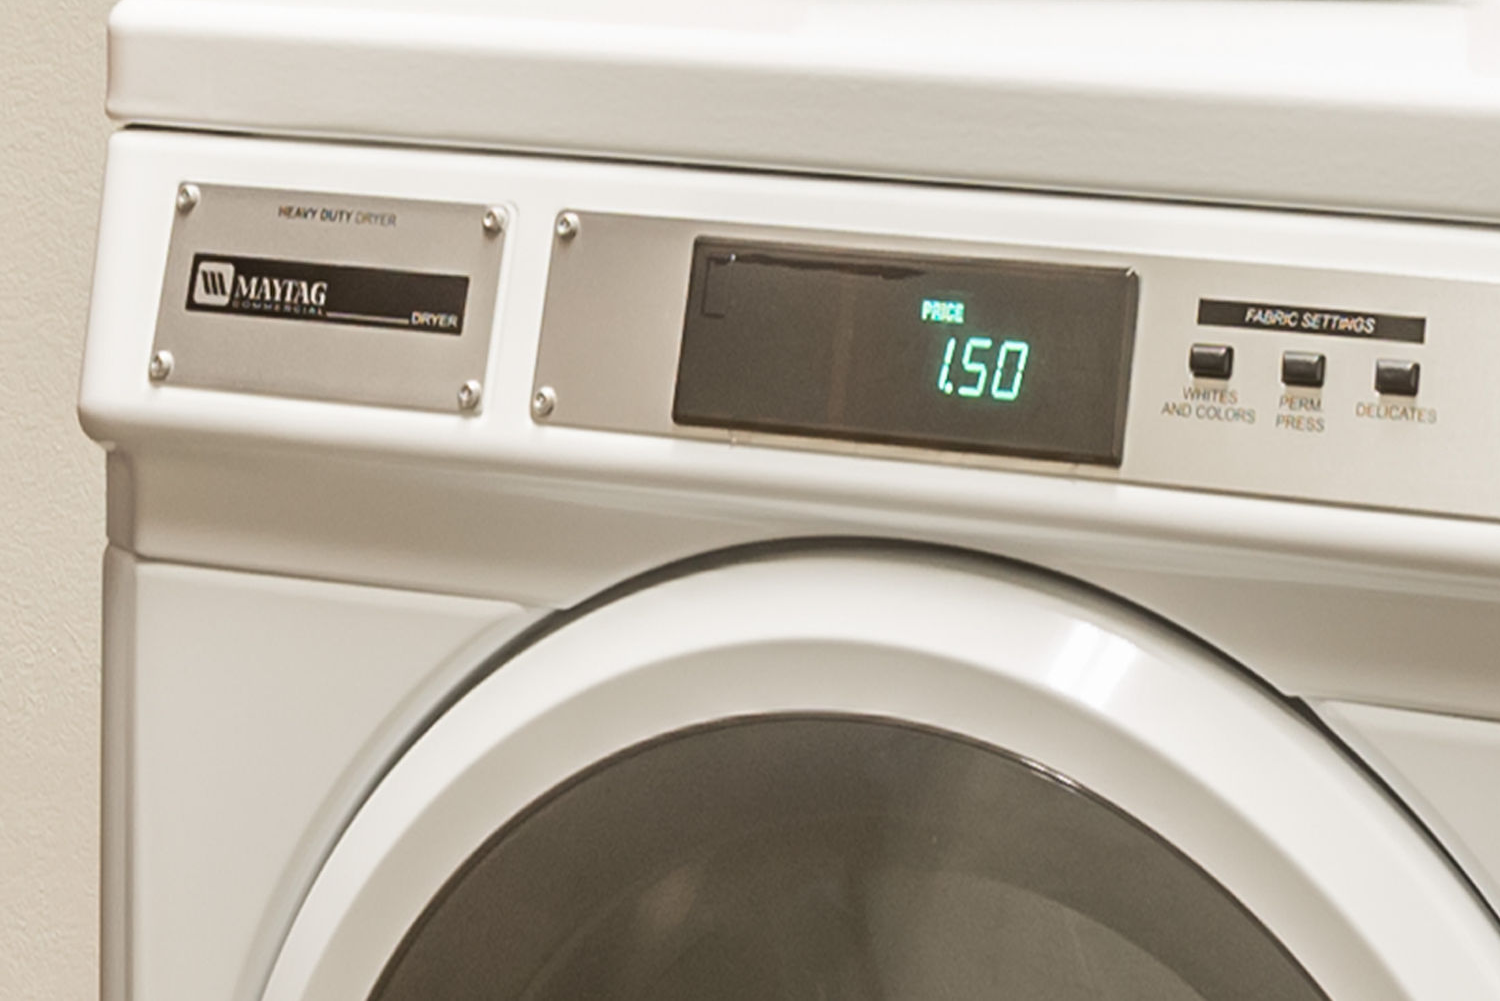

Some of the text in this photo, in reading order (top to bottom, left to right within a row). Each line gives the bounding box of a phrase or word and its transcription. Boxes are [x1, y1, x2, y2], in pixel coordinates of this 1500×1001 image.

[278, 205, 397, 227] HEAVY DUTY DRYER
[234, 275, 328, 306] MAYTAG
[232, 300, 323, 316] COMMERCIAL
[411, 311, 458, 328] DRYER
[1245, 308, 1377, 334] FABRIC SETTINGS
[937, 337, 1029, 400] 1.50
[1183, 387, 1238, 404] WHITES
[1161, 402, 1256, 425] AND COLORS
[1276, 415, 1325, 432] PRESS
[1355, 402, 1437, 424] DELICATES
